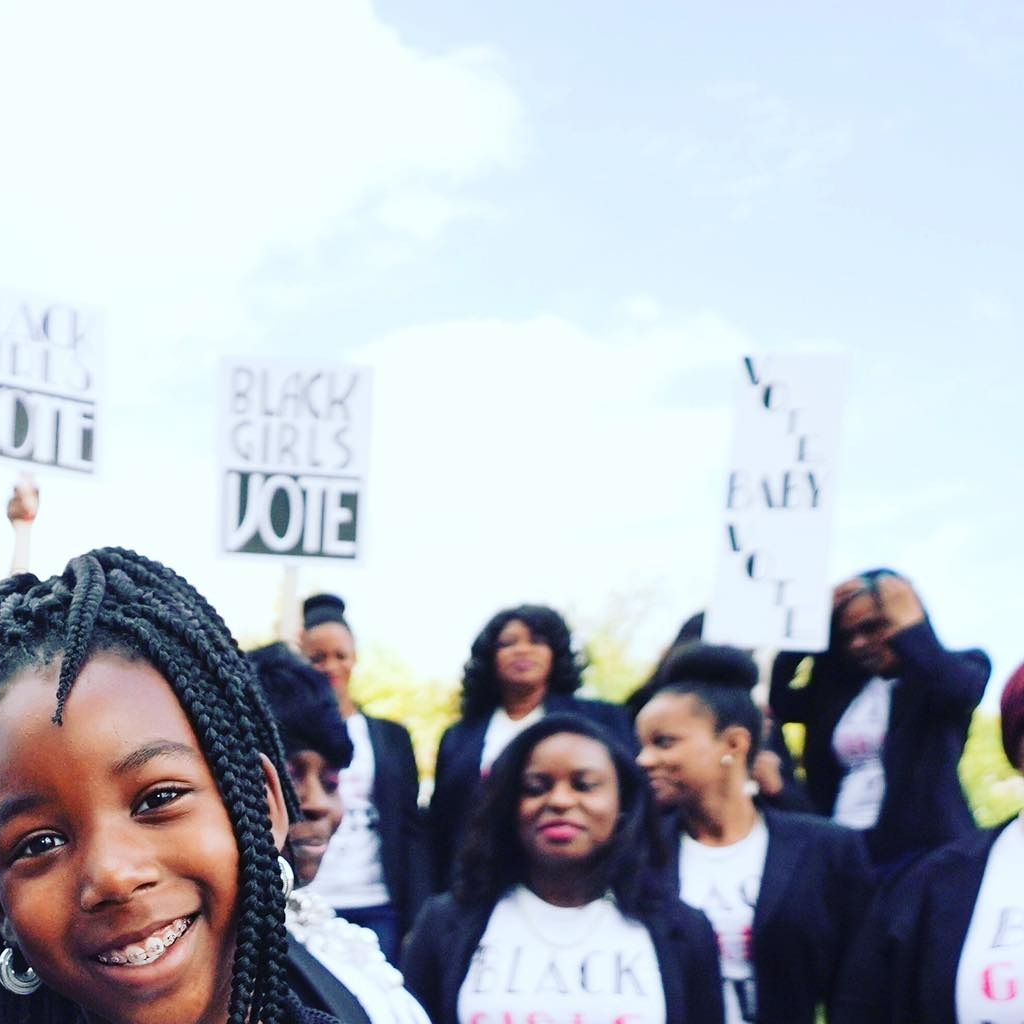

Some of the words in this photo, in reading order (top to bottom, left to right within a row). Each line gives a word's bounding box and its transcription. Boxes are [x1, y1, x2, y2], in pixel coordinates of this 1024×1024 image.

[232, 367, 360, 421] BLACK
[230, 419, 354, 469] GIRLS
[226, 472, 358, 555] VOTE
[472, 945, 647, 996] BLACK
